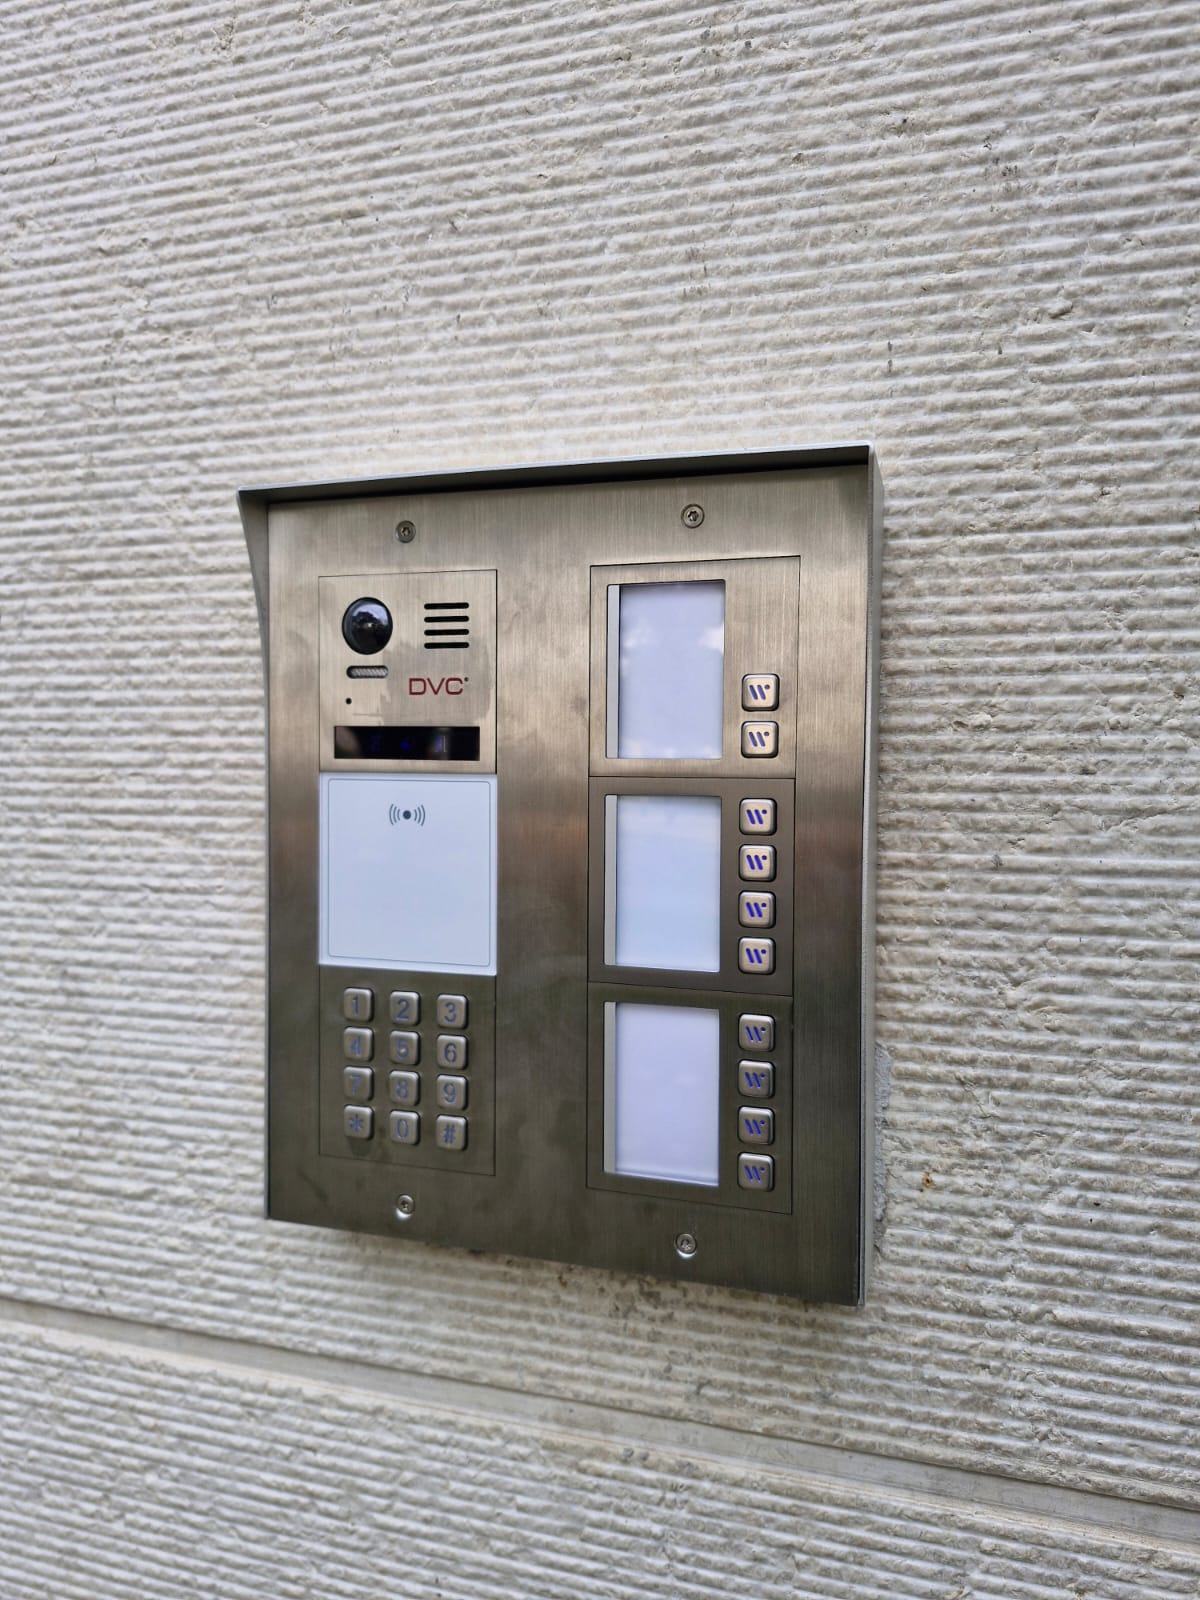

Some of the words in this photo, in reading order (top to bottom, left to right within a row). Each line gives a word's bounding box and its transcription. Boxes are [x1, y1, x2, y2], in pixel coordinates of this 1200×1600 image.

[409, 678, 463, 695] DVC
[352, 996, 360, 1015] 1
[396, 999, 410, 1021] 2
[444, 1002, 457, 1023] 3
[349, 1036, 362, 1056] 4
[397, 1039, 410, 1059] 5
[444, 1042, 457, 1063] 6
[349, 1074, 362, 1095] 7
[396, 1079, 409, 1099] 8
[443, 1083, 457, 1104] 9
[397, 1119, 409, 1138] 0
[443, 1124, 456, 1144] #
